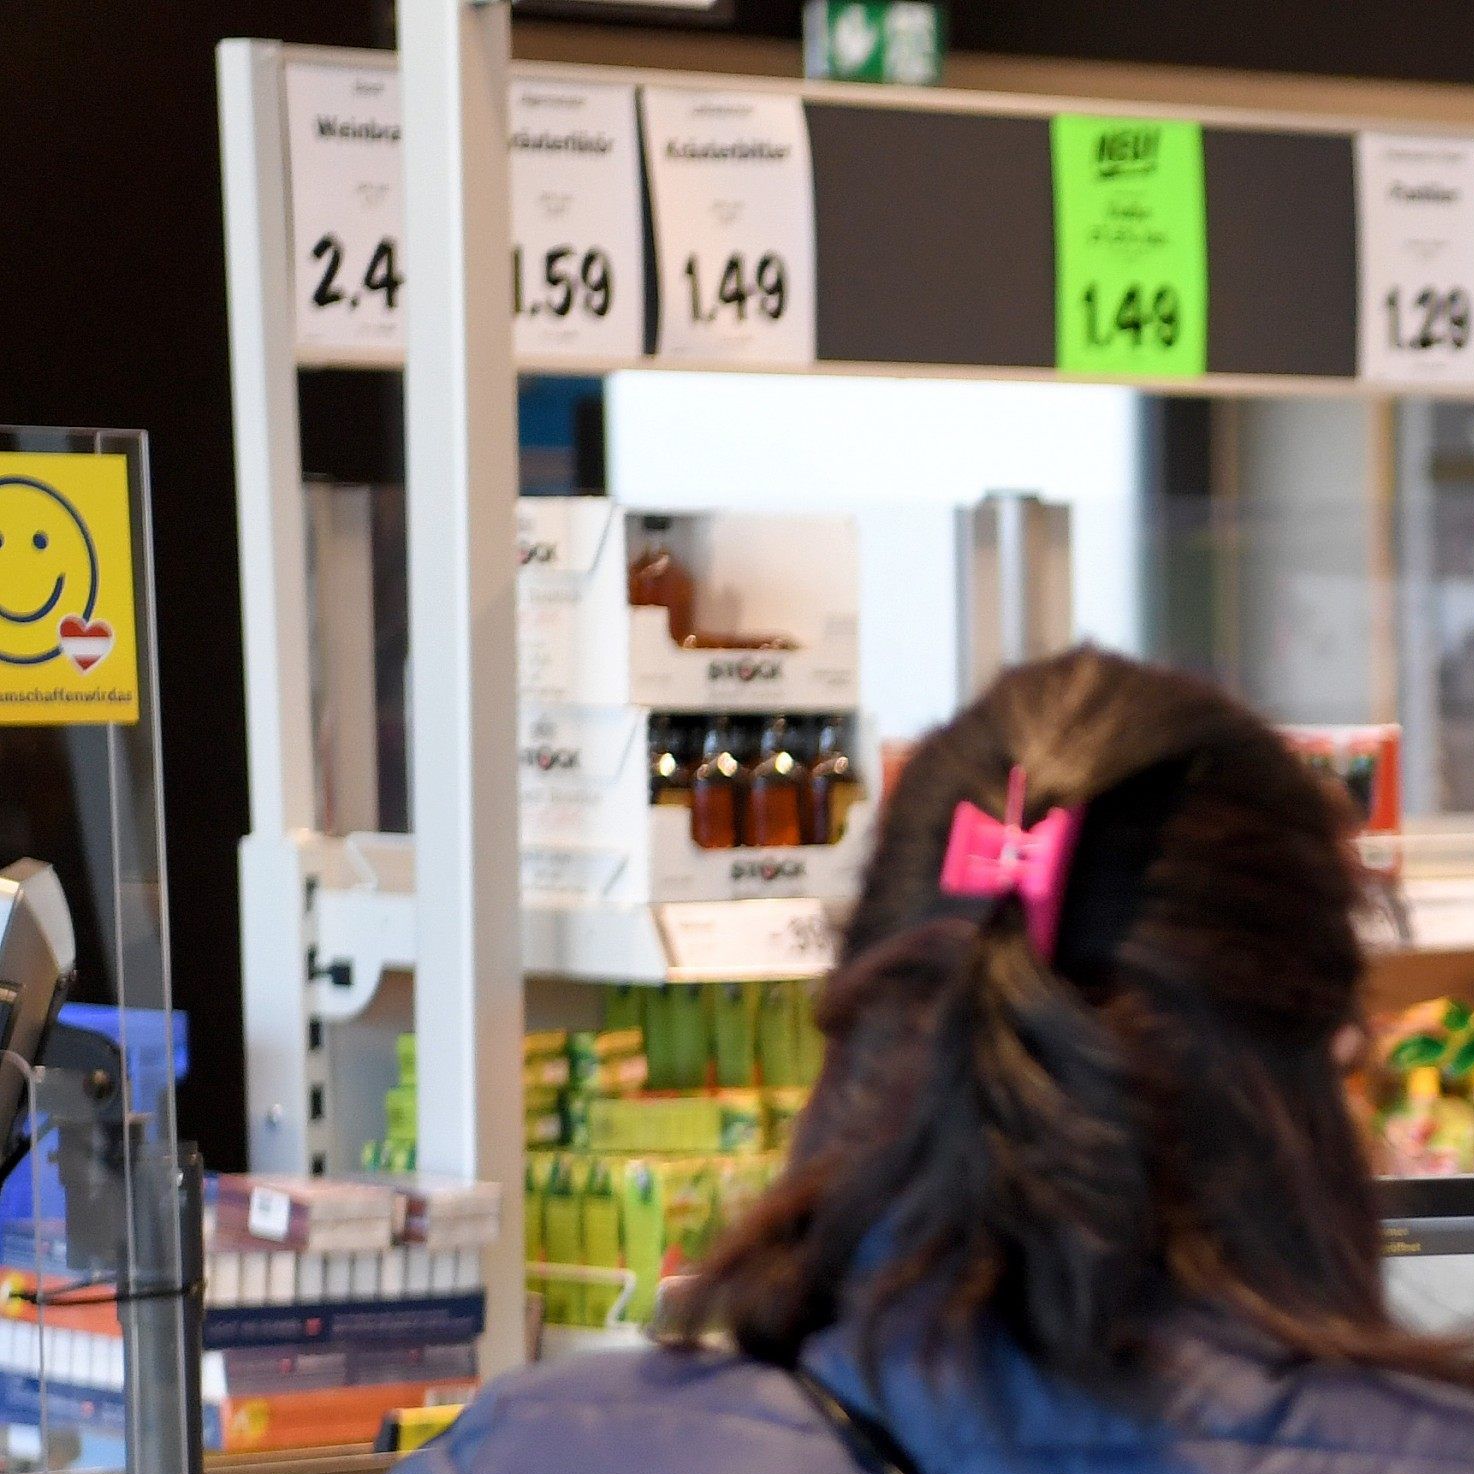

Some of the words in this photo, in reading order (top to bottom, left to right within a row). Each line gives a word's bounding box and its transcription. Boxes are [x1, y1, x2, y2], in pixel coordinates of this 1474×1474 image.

[311, 232, 405, 310] 2.4
[512, 245, 615, 319] 1.59
[684, 250, 787, 322] 1.49
[1081, 284, 1182, 352] 1.49
[1385, 286, 1470, 352] 1.29
